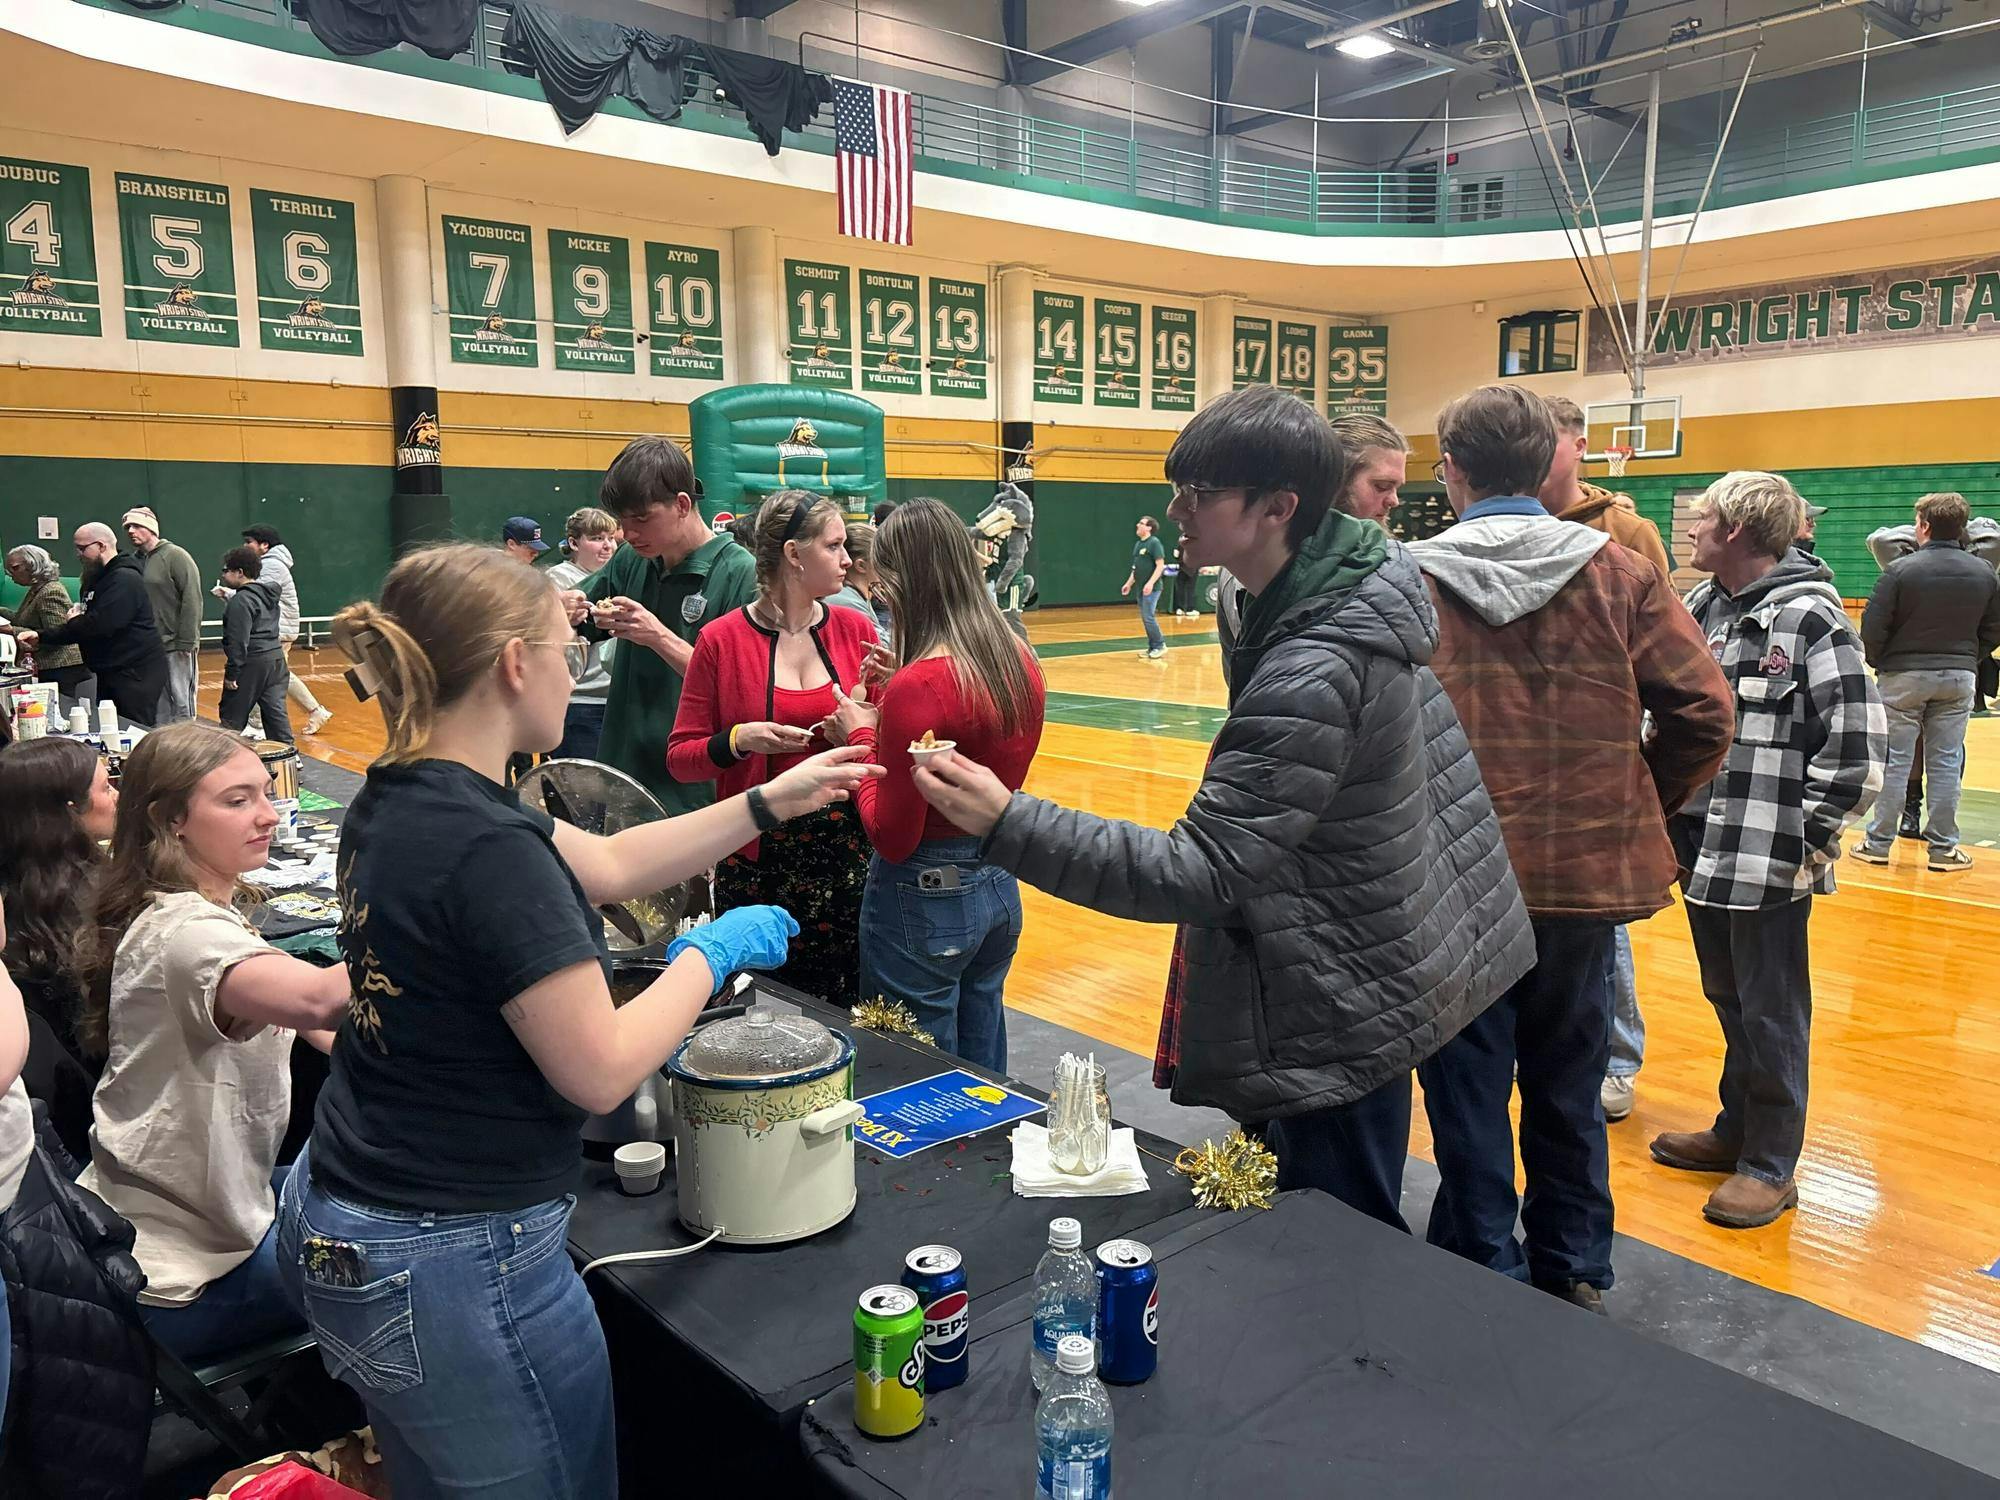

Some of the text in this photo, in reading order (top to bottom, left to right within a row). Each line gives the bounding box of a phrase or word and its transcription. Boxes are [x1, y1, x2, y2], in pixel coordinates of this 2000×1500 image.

[119, 179, 227, 206] BRANSFIELD
[270, 198, 337, 219] TERRILL
[6, 200, 61, 267] 4
[449, 222, 526, 243] YACOBUCCI
[151, 214, 204, 280] 5
[567, 237, 611, 253] MCKEE
[283, 230, 331, 293] 6
[667, 250, 699, 264] AYRO
[469, 251, 510, 308] 7
[795, 266, 840, 280] SCHMIDT
[866, 275, 914, 290] BORTULIN
[572, 264, 611, 318] 9
[654, 274, 714, 328] 10
[939, 284, 975, 297] FURLAN
[798, 290, 841, 340] 11
[1104, 304, 1132, 316] COOPER
[1649, 284, 1872, 355] WRIGHT
[141, 317, 227, 334] VOLLEYBALL
[866, 298, 915, 347] 12
[935, 305, 980, 353] 13
[273, 327, 352, 344] VOLLEYBALL
[1038, 317, 1077, 361] 14
[1098, 324, 1136, 366] 15
[461, 342, 528, 356] VOLLEYBALL
[565, 350, 626, 363] VOLLEYBALL
[1155, 330, 1191, 371] 16
[1235, 339, 1267, 377] 17
[659, 358, 715, 370] VOLLEYBALL
[796, 368, 845, 379] VOLLEYBALL
[1280, 344, 1312, 382] 18
[1330, 346, 1386, 383] 35
[869, 374, 915, 385] VOLLEYBALL
[937, 379, 981, 390] VOLLEYBALL
[1039, 386, 1078, 396] VOLLEYBALL
[1099, 390, 1136, 400] VOLLEYBALL
[1146, 1308, 1158, 1328] P
